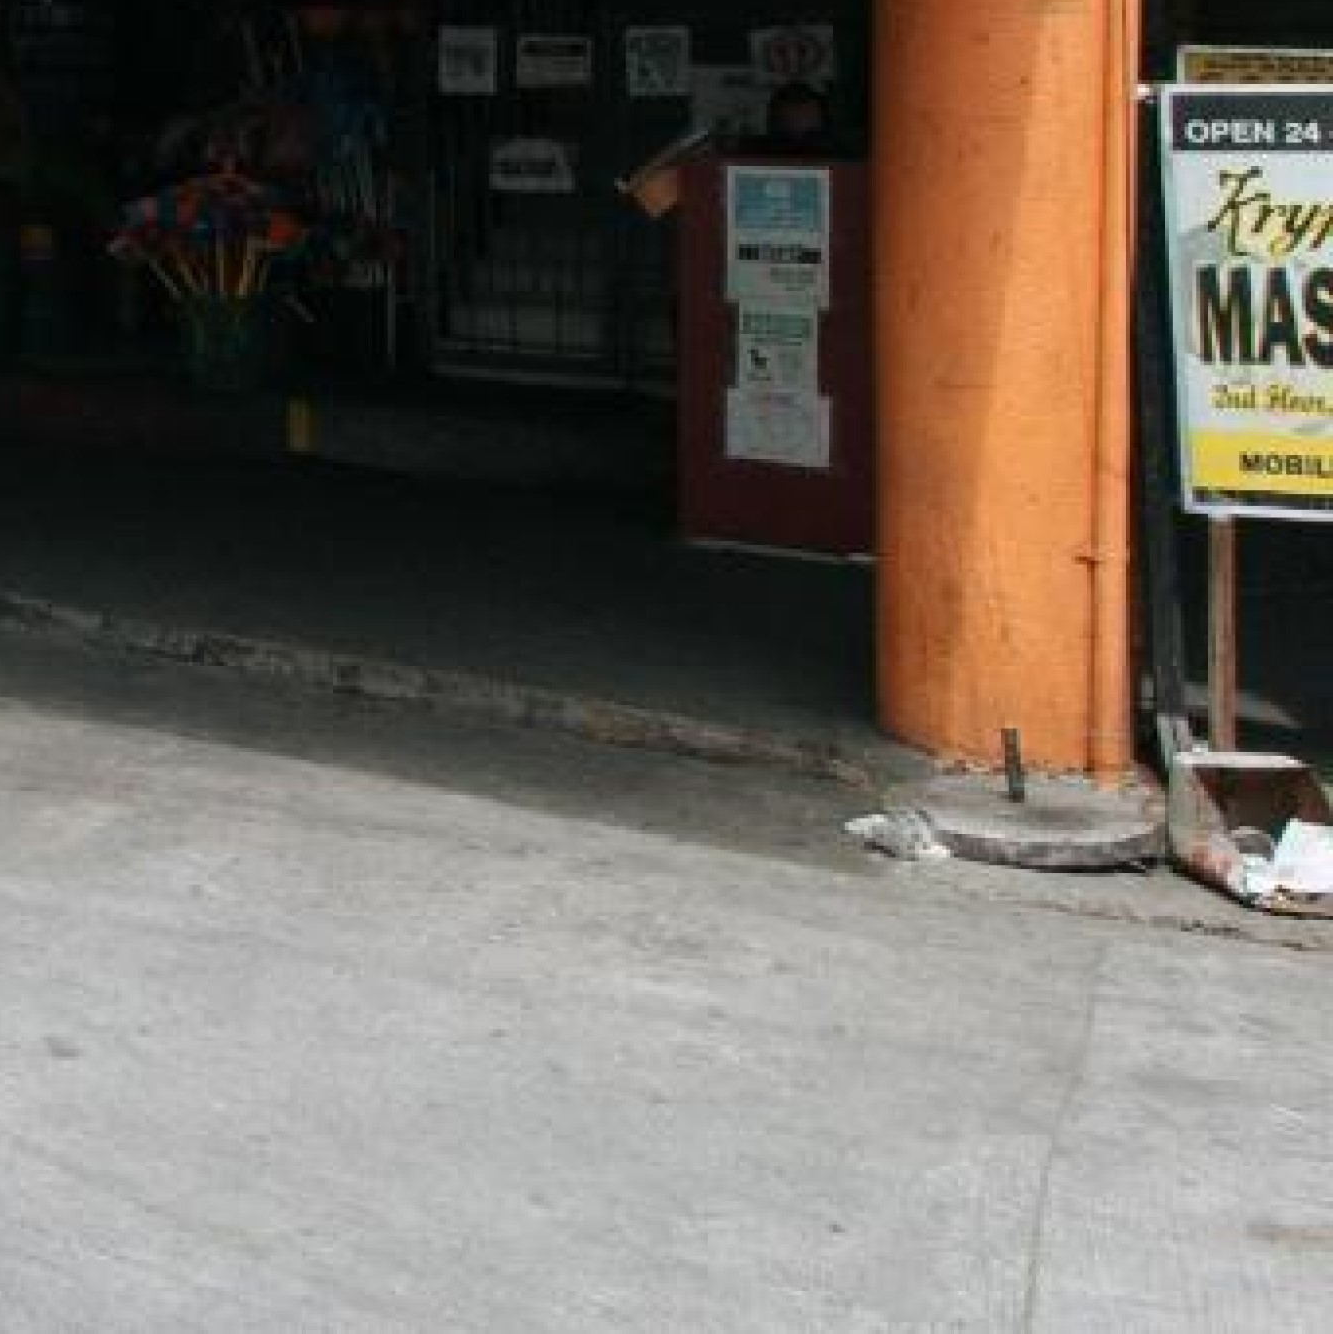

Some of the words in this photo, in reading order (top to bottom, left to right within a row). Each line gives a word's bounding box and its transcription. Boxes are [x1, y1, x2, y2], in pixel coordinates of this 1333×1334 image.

[1186, 121, 1275, 144] OPEN
[1285, 121, 1319, 144] 24
[1239, 451, 1333, 479] MOBIL
